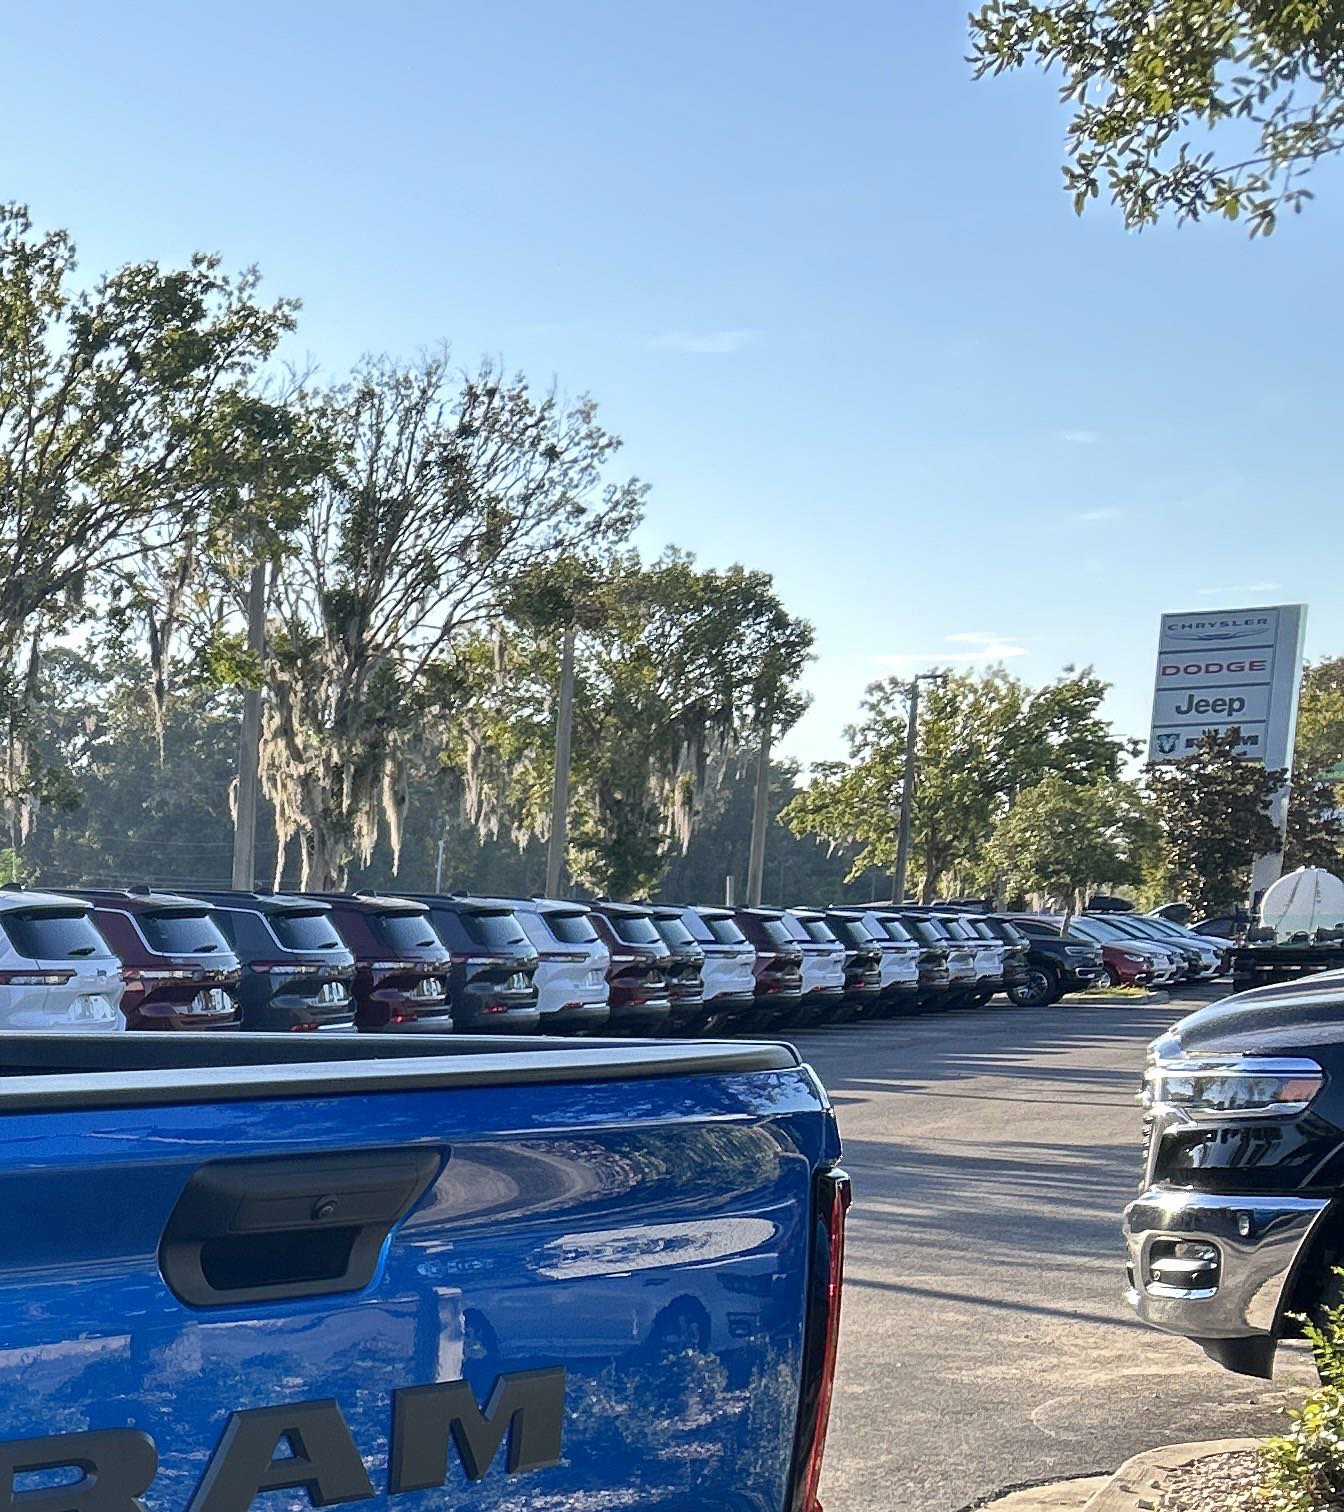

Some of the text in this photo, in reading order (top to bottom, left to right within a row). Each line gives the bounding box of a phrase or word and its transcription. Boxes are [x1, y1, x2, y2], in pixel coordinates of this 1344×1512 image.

[1167, 618, 1269, 631] CHRYSLER
[1161, 660, 1267, 676] DODGE
[1175, 694, 1246, 717] Jeep
